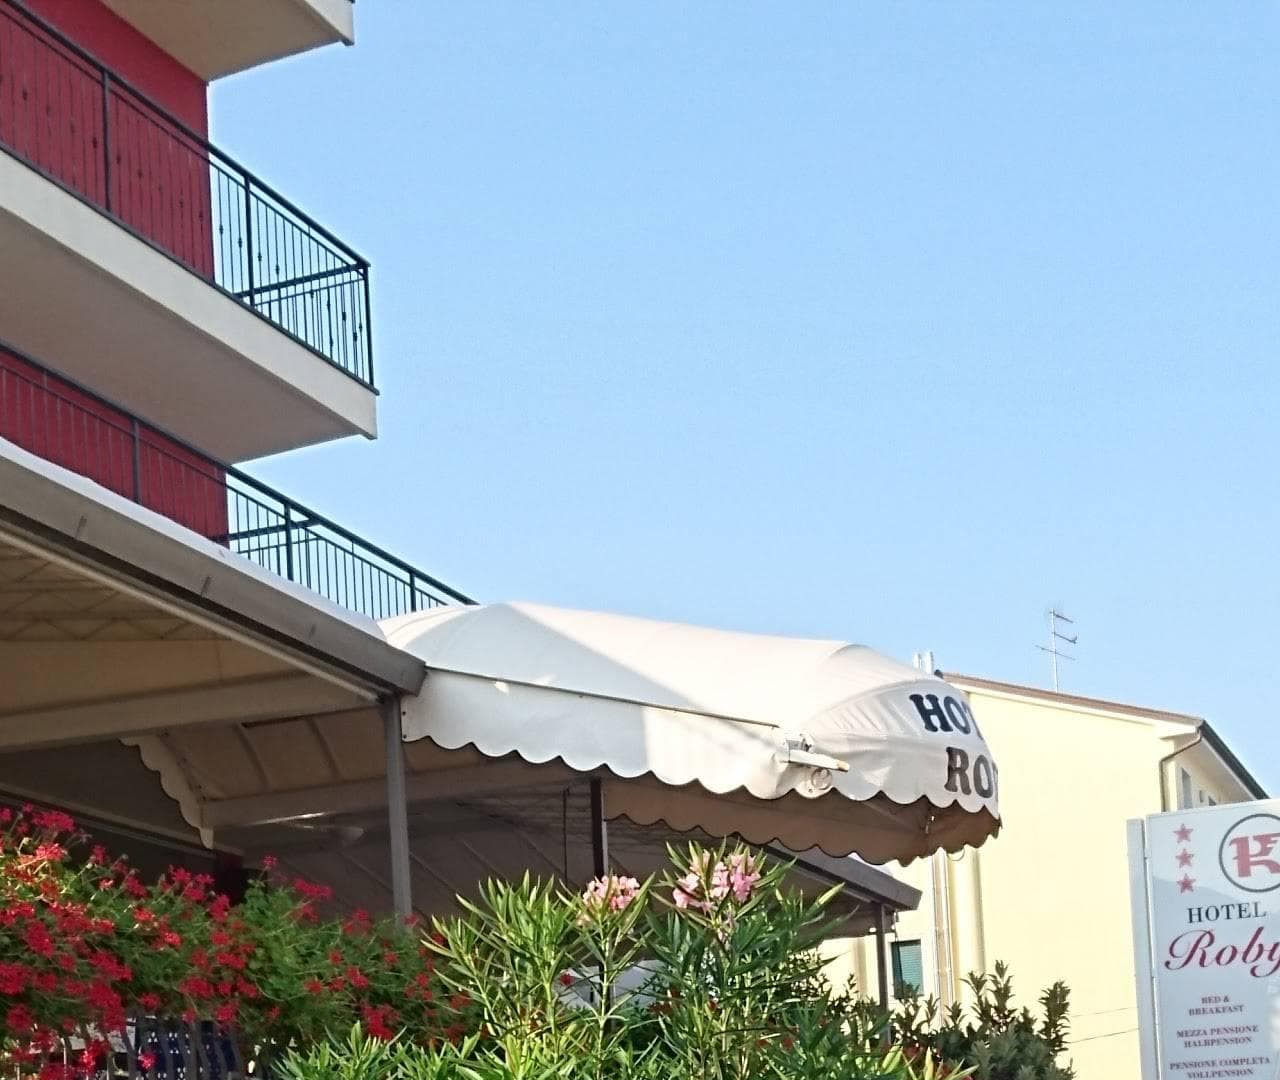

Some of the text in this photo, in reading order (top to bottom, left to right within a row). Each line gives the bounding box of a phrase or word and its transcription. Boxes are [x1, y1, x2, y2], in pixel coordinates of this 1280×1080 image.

[909, 694, 983, 740] HO
[944, 746, 998, 800] RO
[1187, 901, 1267, 924] HOTEL
[1201, 995, 1229, 1004] BED &
[1188, 1004, 1244, 1016] BREAKFAST
[1176, 1025, 1259, 1038] MEZZA PENSIONE
[1184, 1036, 1252, 1048] HALBPENSION
[1169, 1056, 1270, 1070] PENSIONE COMPLETA
[1187, 1068, 1254, 1079] VOLLPENSION
